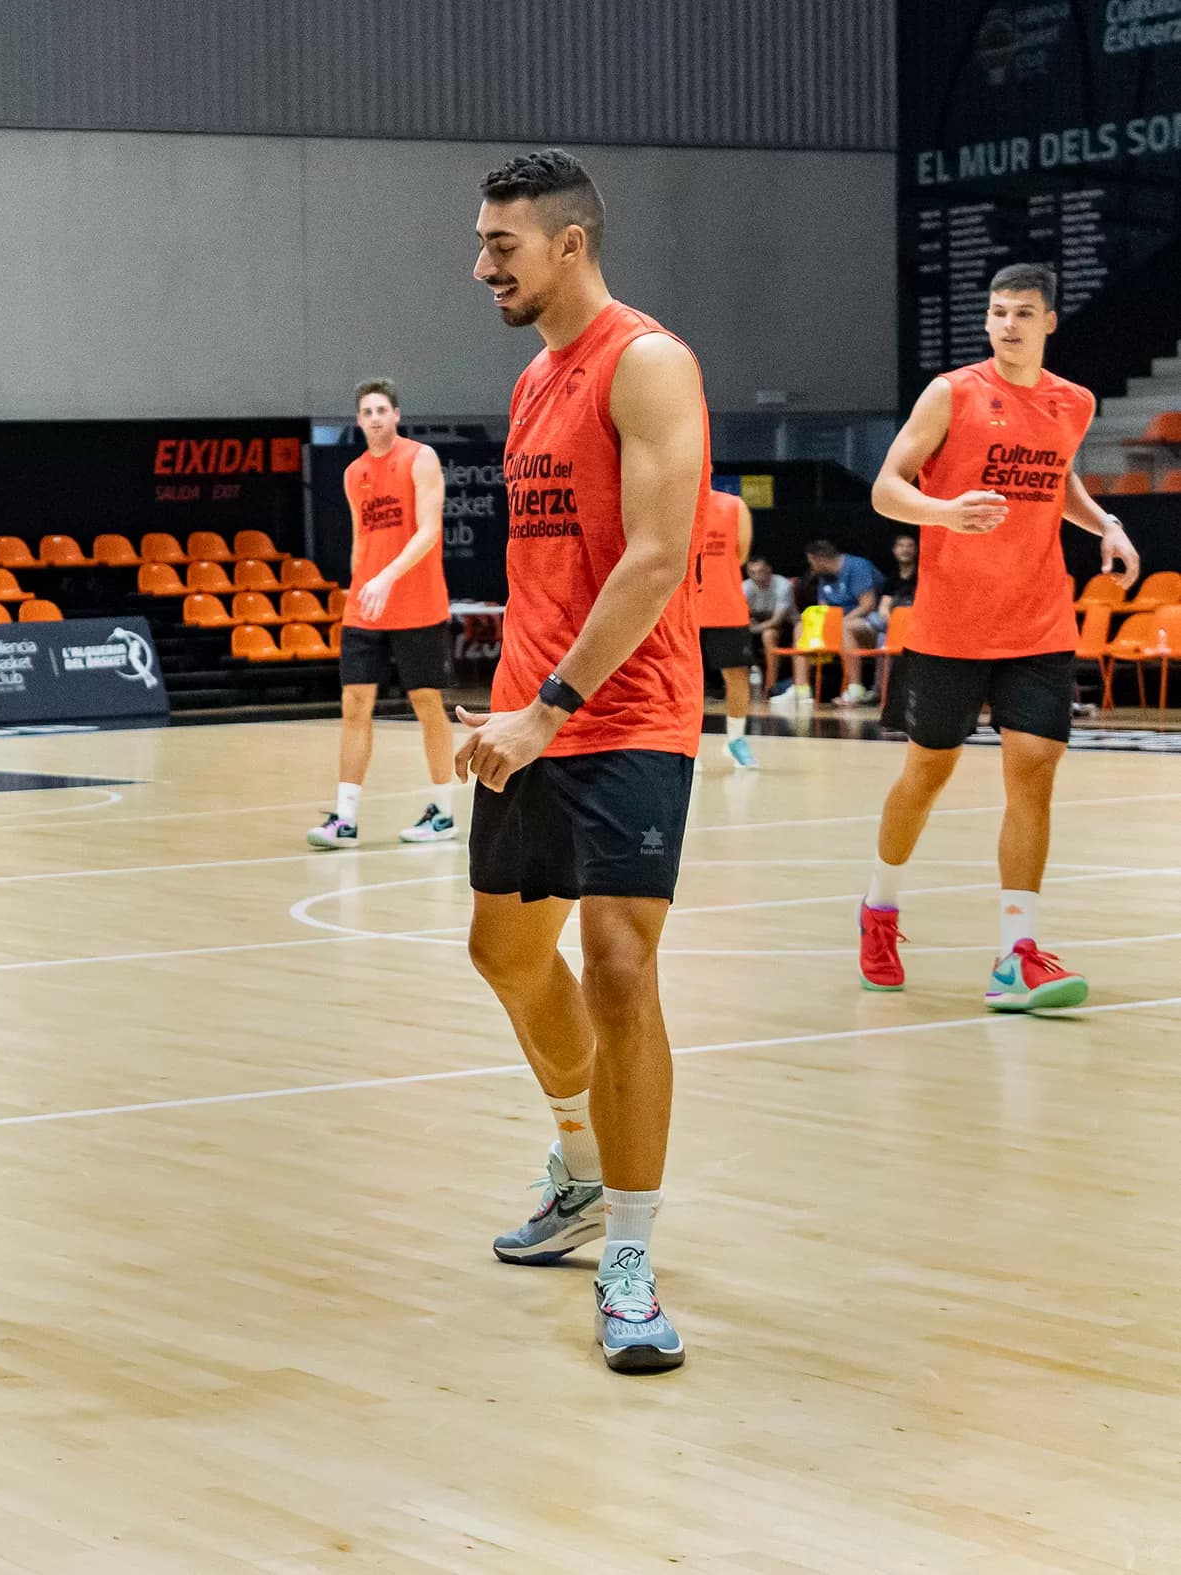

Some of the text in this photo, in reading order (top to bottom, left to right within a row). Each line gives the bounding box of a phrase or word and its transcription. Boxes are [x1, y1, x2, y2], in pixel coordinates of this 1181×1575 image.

[917, 151, 951, 186] EL
[958, 137, 1030, 178] MUR
[1039, 123, 1118, 168] DELS
[154, 438, 265, 475] EIXIDA
[987, 443, 1057, 466] Cultura
[554, 461, 573, 479] del
[443, 488, 494, 516] asket
[444, 518, 474, 545] ub
